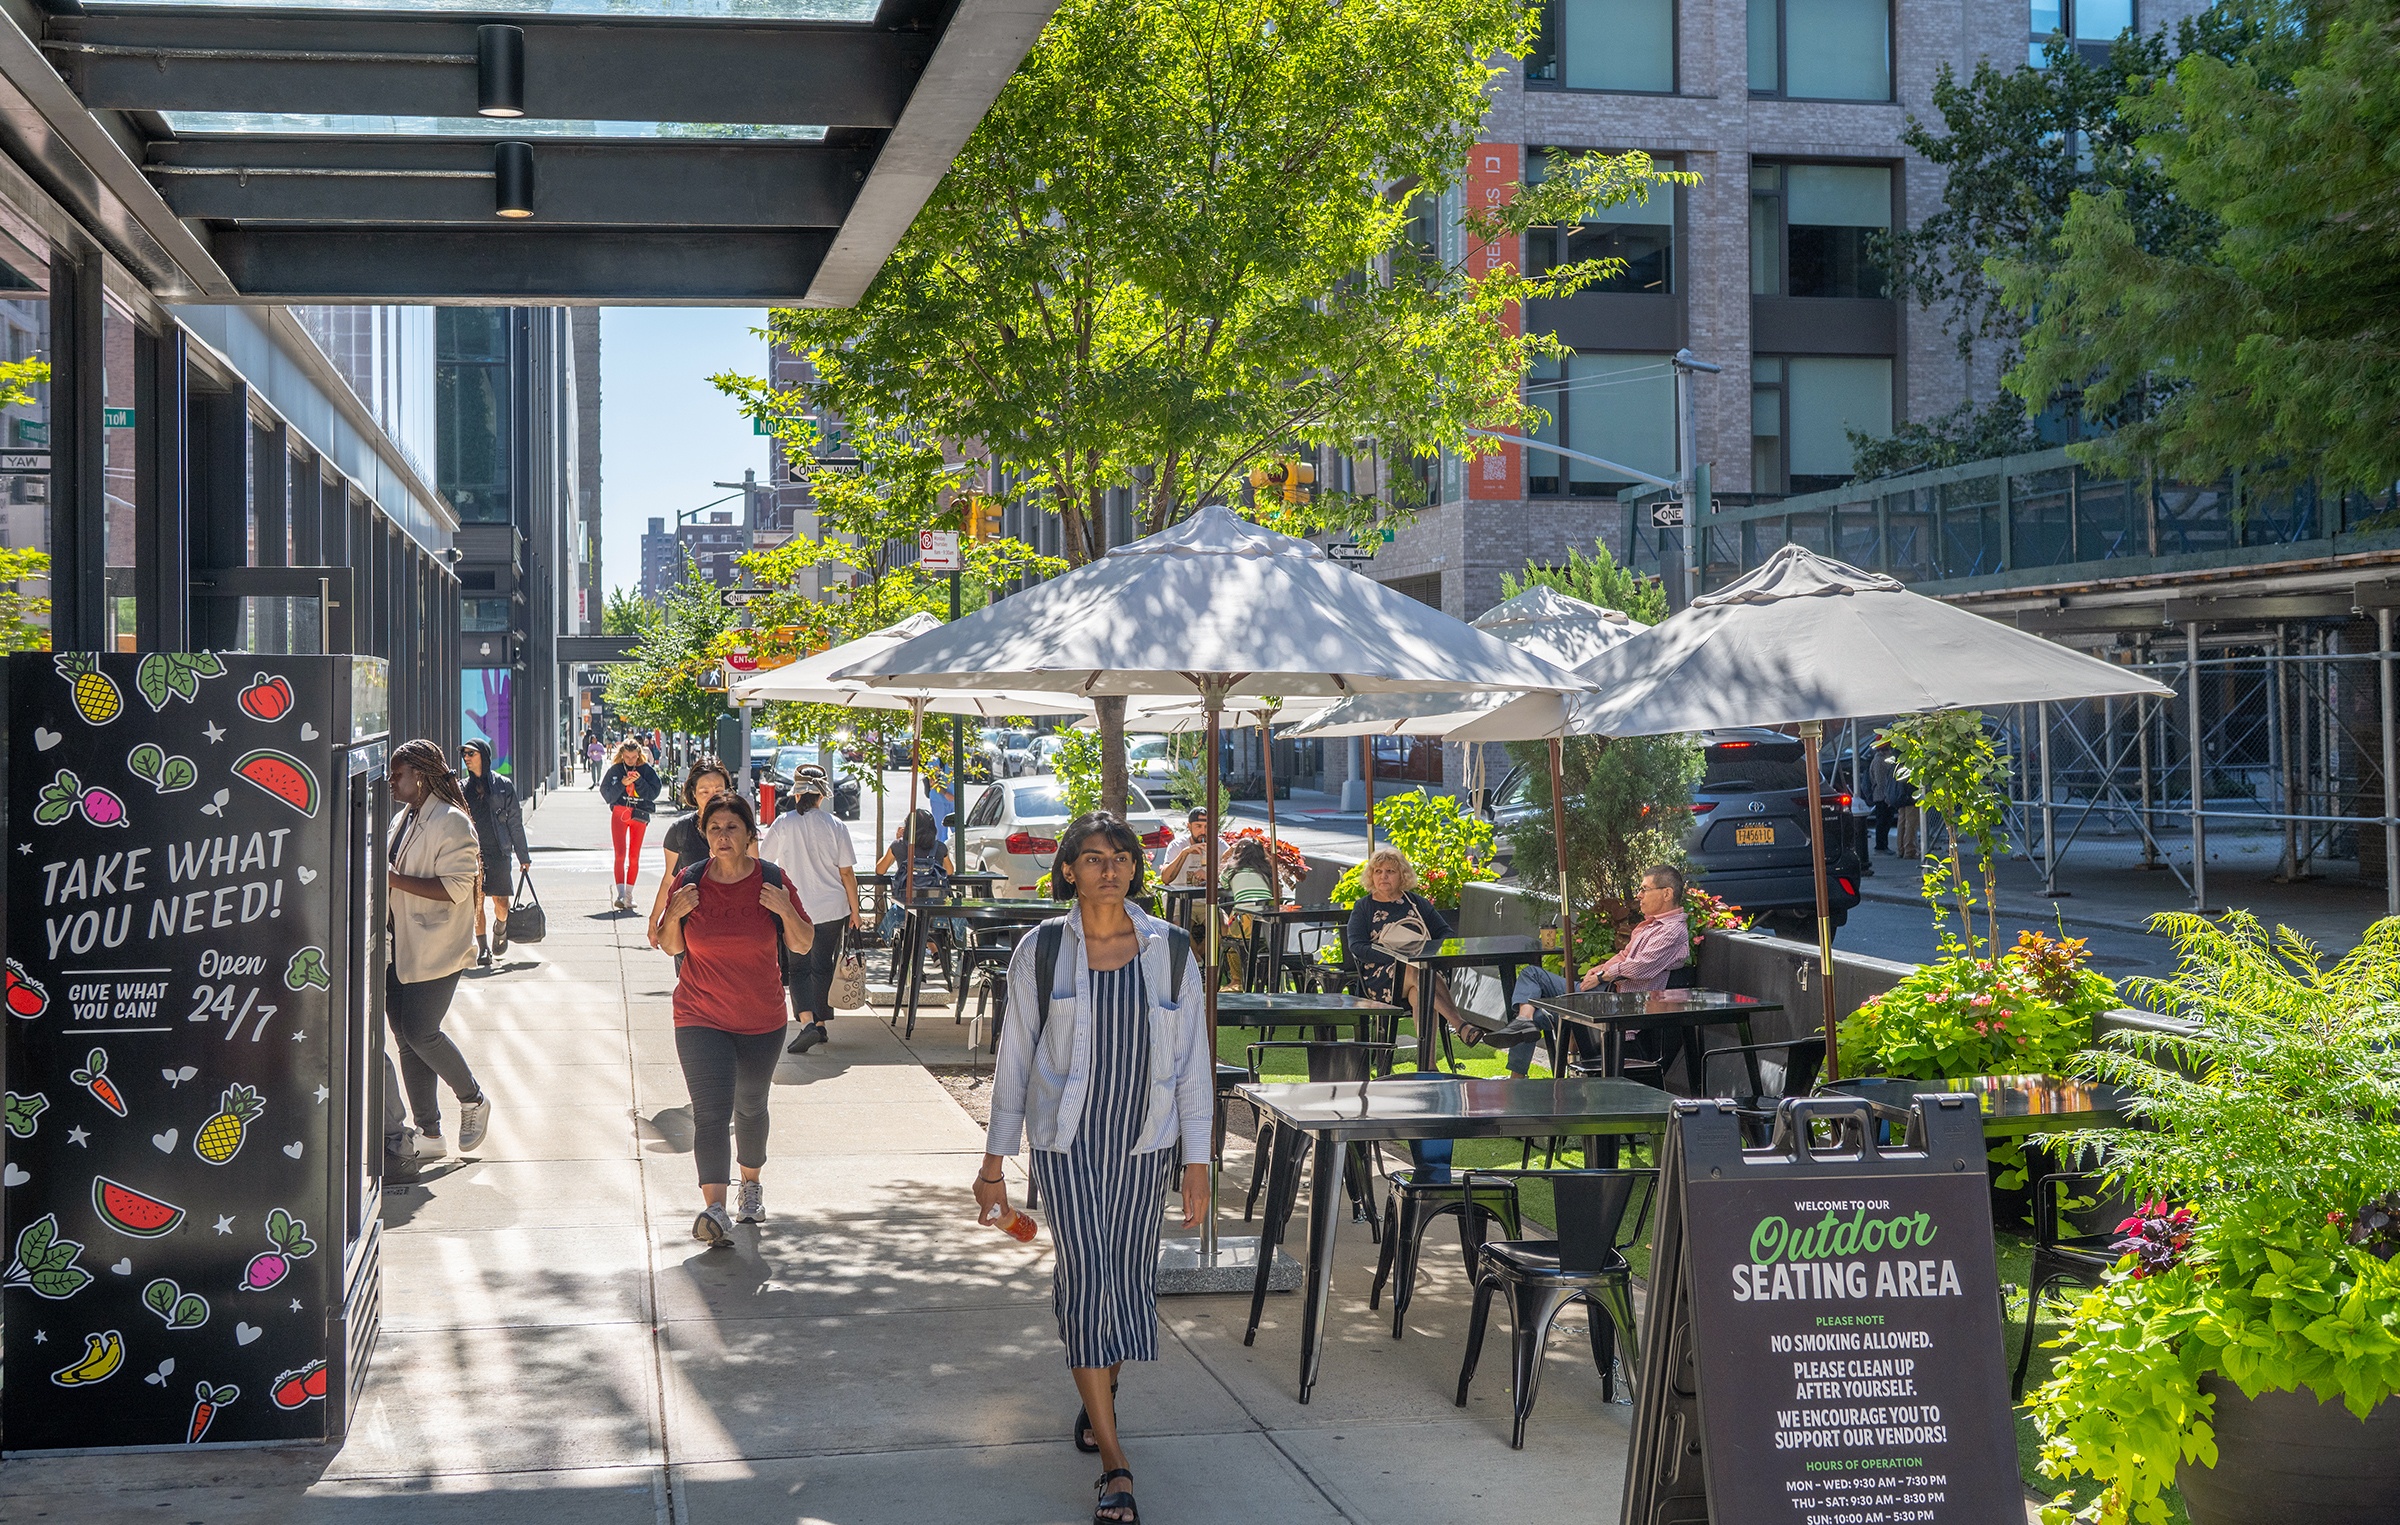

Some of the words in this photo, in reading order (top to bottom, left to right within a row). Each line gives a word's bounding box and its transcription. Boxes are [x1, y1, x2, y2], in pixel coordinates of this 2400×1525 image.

[1486, 187, 1501, 269] REALS
[1661, 510, 1682, 520] ONE
[42, 848, 151, 906] TAKE
[168, 828, 291, 883] WHAT
[46, 904, 132, 960] YOU
[148, 879, 283, 939] NEED!
[199, 950, 267, 980] Open
[68, 984, 111, 1001] GIVE
[116, 982, 168, 999] WHAT
[73, 1004, 109, 1020] YOU
[114, 1002, 156, 1018] CAN!
[188, 985, 278, 1042] 24/7
[1795, 1201, 1847, 1212] WELCOME
[1848, 1201, 1865, 1211] TO
[1866, 1200, 1890, 1210] OUR
[1750, 1206, 1938, 1266] Outdoor
[1732, 1262, 1867, 1301] SEATING
[1875, 1259, 1962, 1298] AREA
[1816, 1316, 1854, 1326] PLEASE
[1856, 1315, 1885, 1325] NOTE
[1771, 1335, 1792, 1353] NO
[1794, 1333, 1861, 1352] SMOKING
[1863, 1331, 1934, 1350] ALLOWED.
[1794, 1361, 1846, 1379] PLEASE
[1848, 1360, 1893, 1378] CLEAN
[1895, 1359, 1915, 1376] UP
[1796, 1381, 1841, 1400] AFTER
[1842, 1379, 1918, 1398] YOURSELF.
[1777, 1410, 1801, 1428] WE
[1803, 1407, 1887, 1427] ENCOURAGE
[1890, 1406, 1919, 1425] YOU
[1920, 1405, 1940, 1424] TO
[1775, 1431, 1841, 1450] SUPPORT
[1843, 1429, 1874, 1447] OUR
[1876, 1426, 1948, 1445] VENDORS!
[1806, 1461, 1844, 1472] HOURS
[1846, 1460, 1859, 1470] OF
[1861, 1458, 1923, 1469] OPERATION
[1786, 1481, 1813, 1492] MON
[1823, 1479, 1852, 1490] WED:
[1853, 1478, 1875, 1489] 9:30
[1878, 1477, 1896, 1488] AM
[1905, 1476, 1928, 1487] 7:30
[1930, 1475, 1947, 1486] PM
[1792, 1498, 1815, 1509] THU
[1826, 1497, 1849, 1508] SAT:
[1851, 1496, 1873, 1506] 9:30
[1875, 1495, 1893, 1505] AM
[1903, 1493, 1925, 1504] 8:30
[1928, 1492, 1945, 1503] PM
[1807, 1515, 1832, 1525] SUN:
[1834, 1513, 1862, 1524] 10:00
[1865, 1512, 1883, 1523] AM
[1894, 1511, 1915, 1521] 5:30
[1917, 1510, 1934, 1520] PM
